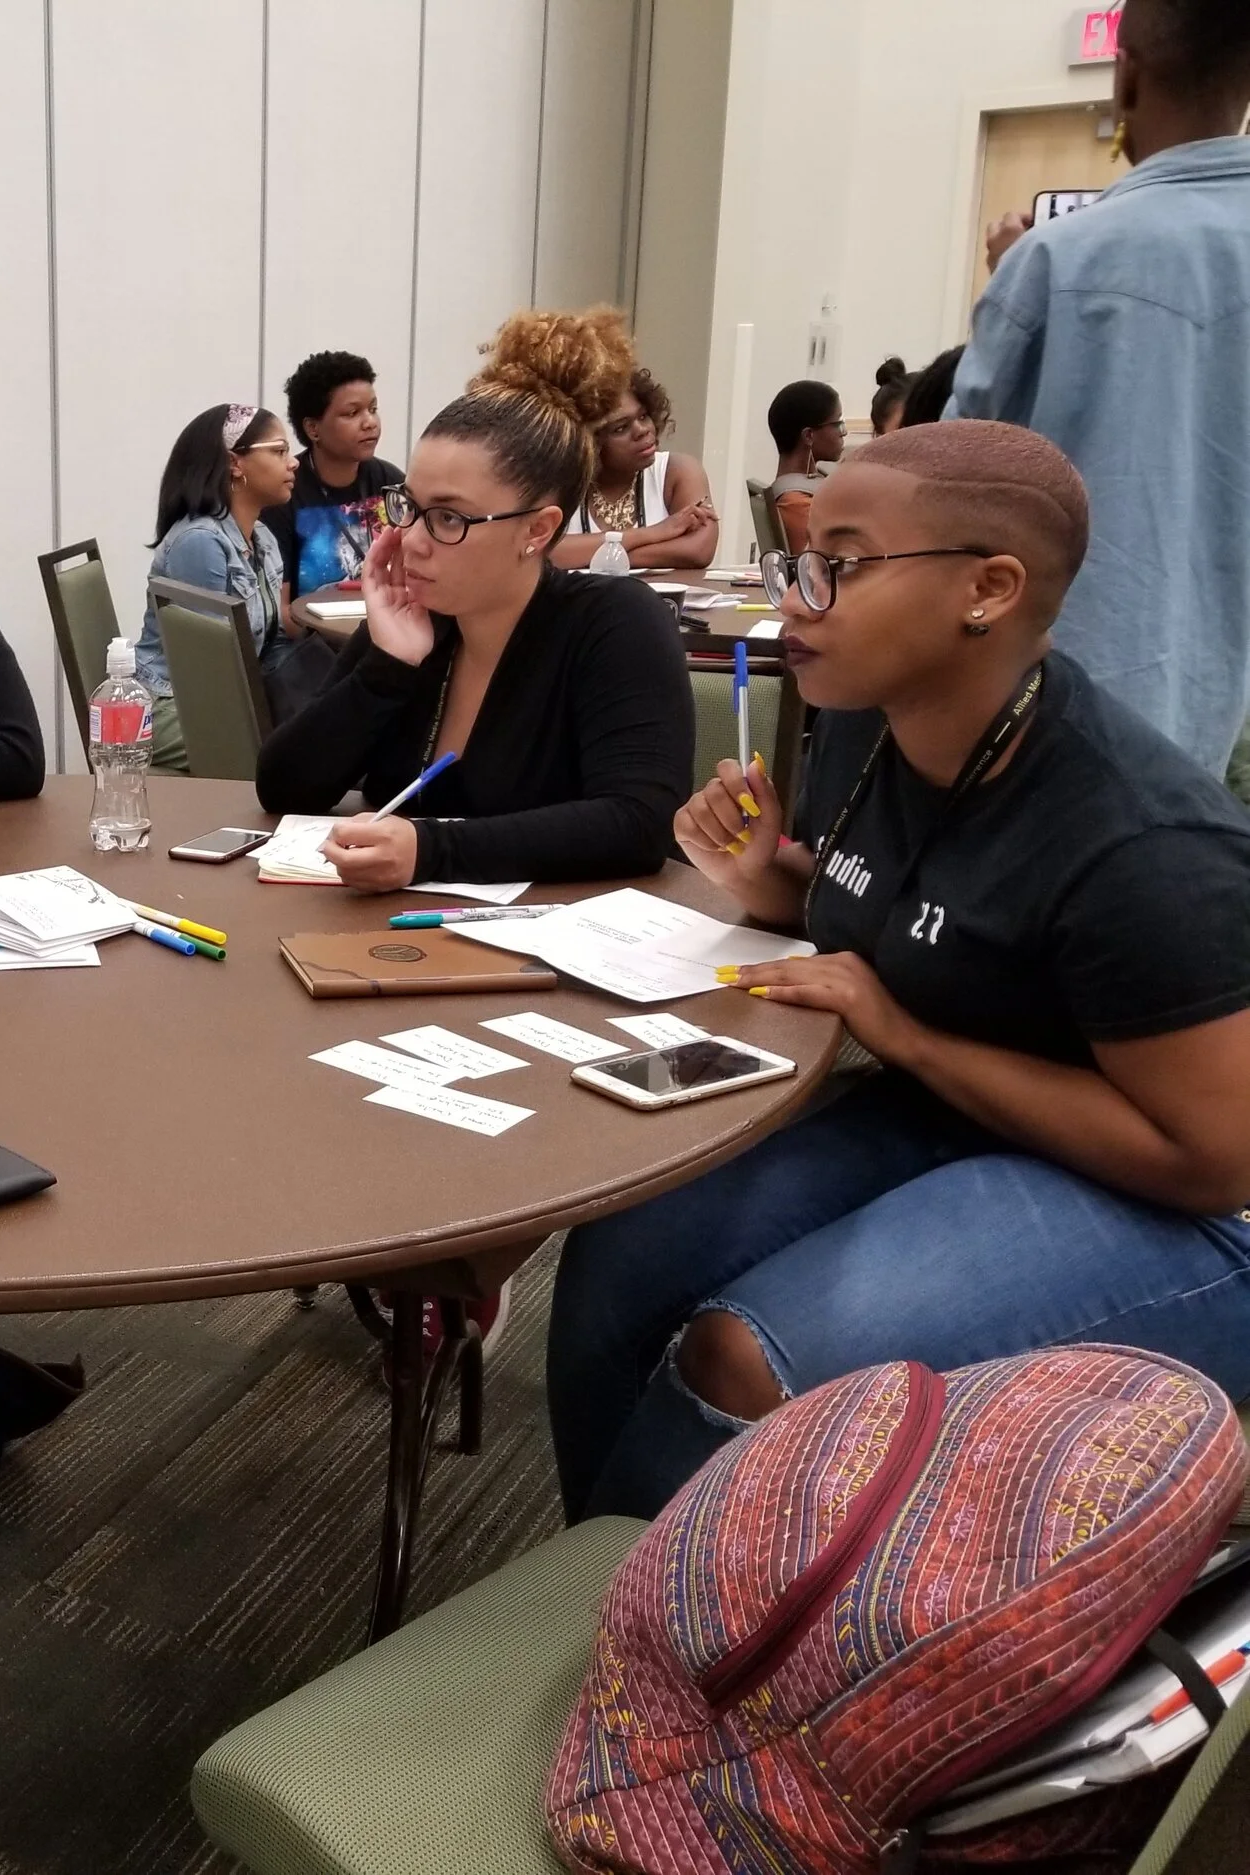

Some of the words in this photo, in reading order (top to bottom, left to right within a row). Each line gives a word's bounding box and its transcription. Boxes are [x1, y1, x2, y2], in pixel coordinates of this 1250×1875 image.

[1013, 691, 1033, 716] Allied
[832, 806, 848, 832] Allied
[911, 901, 945, 945] 27
